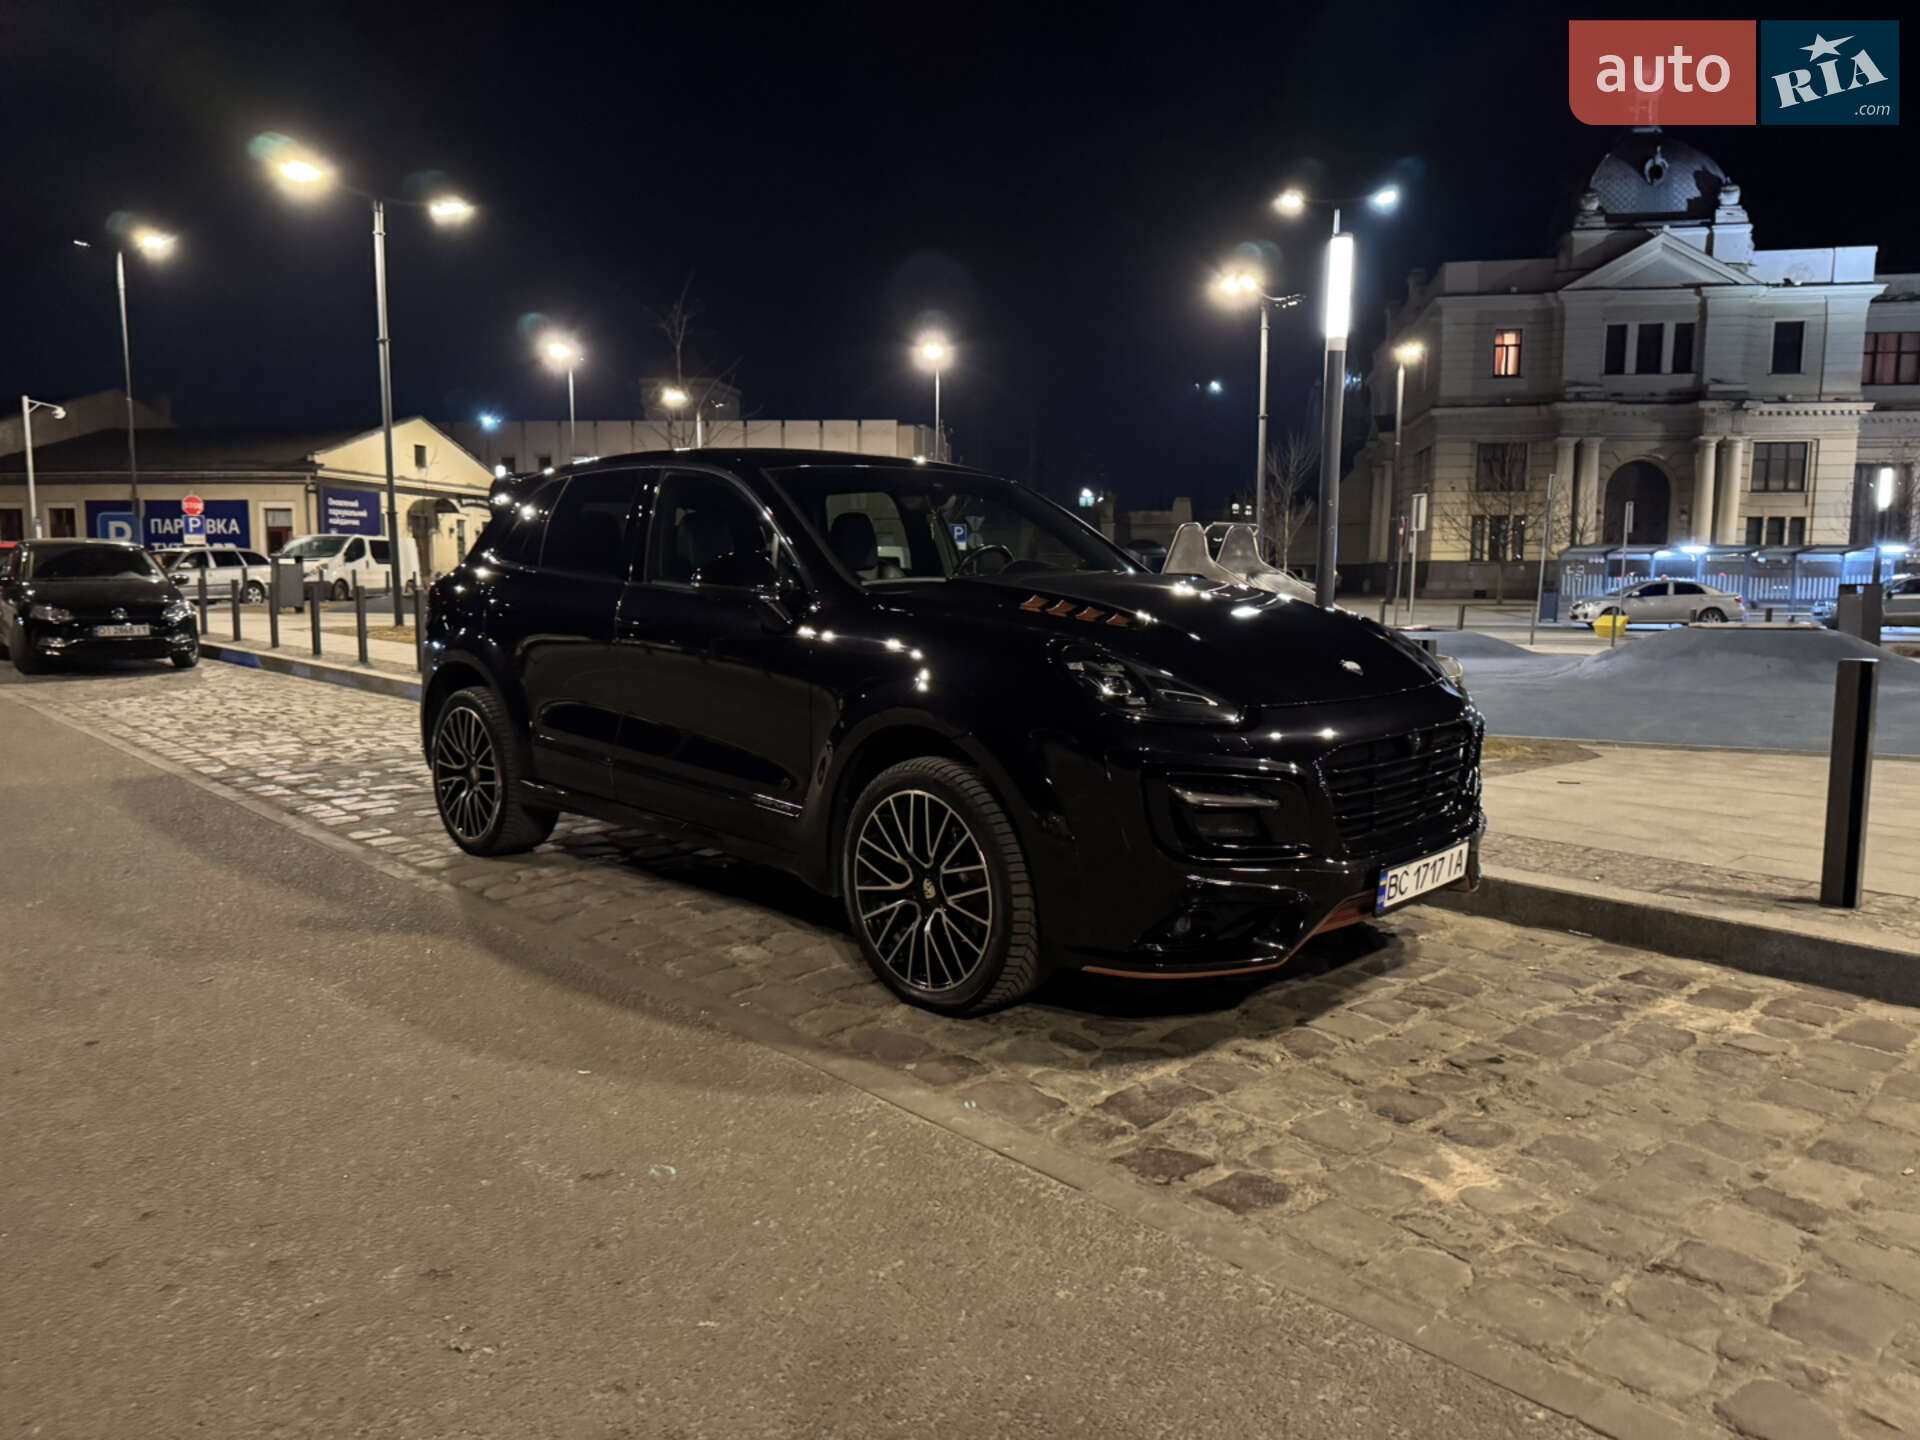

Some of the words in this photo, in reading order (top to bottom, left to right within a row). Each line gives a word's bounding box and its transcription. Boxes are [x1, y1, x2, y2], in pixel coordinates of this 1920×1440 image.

[151, 518, 241, 534] ПАРВКА
[189, 517, 202, 533] P
[953, 526, 965, 540] P
[1387, 870, 1409, 901] BC
[1413, 856, 1445, 891] 1717
[1447, 849, 1463, 877] IA
